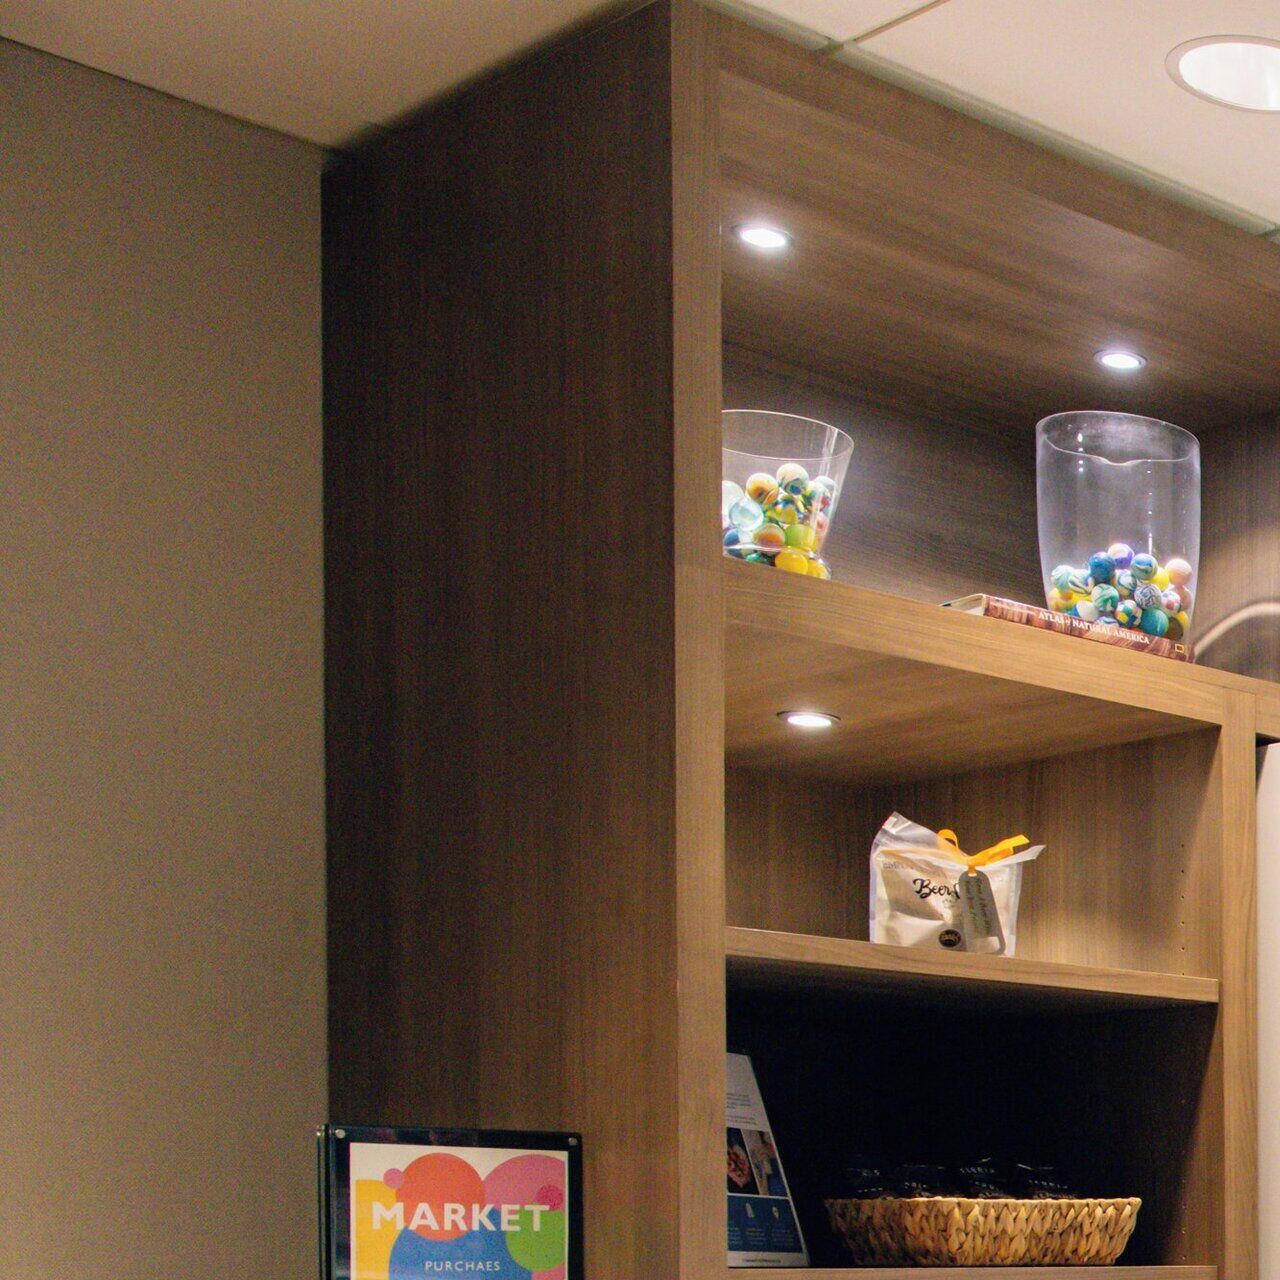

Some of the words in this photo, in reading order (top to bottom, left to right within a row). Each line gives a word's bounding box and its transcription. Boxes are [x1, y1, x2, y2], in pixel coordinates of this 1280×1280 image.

[1038, 611, 1064, 625] ATLAS
[1072, 619, 1113, 636] NATURAL
[1113, 628, 1150, 645] AMERICA
[371, 1201, 550, 1232] MARKET
[424, 1260, 501, 1272] PURCHAES
